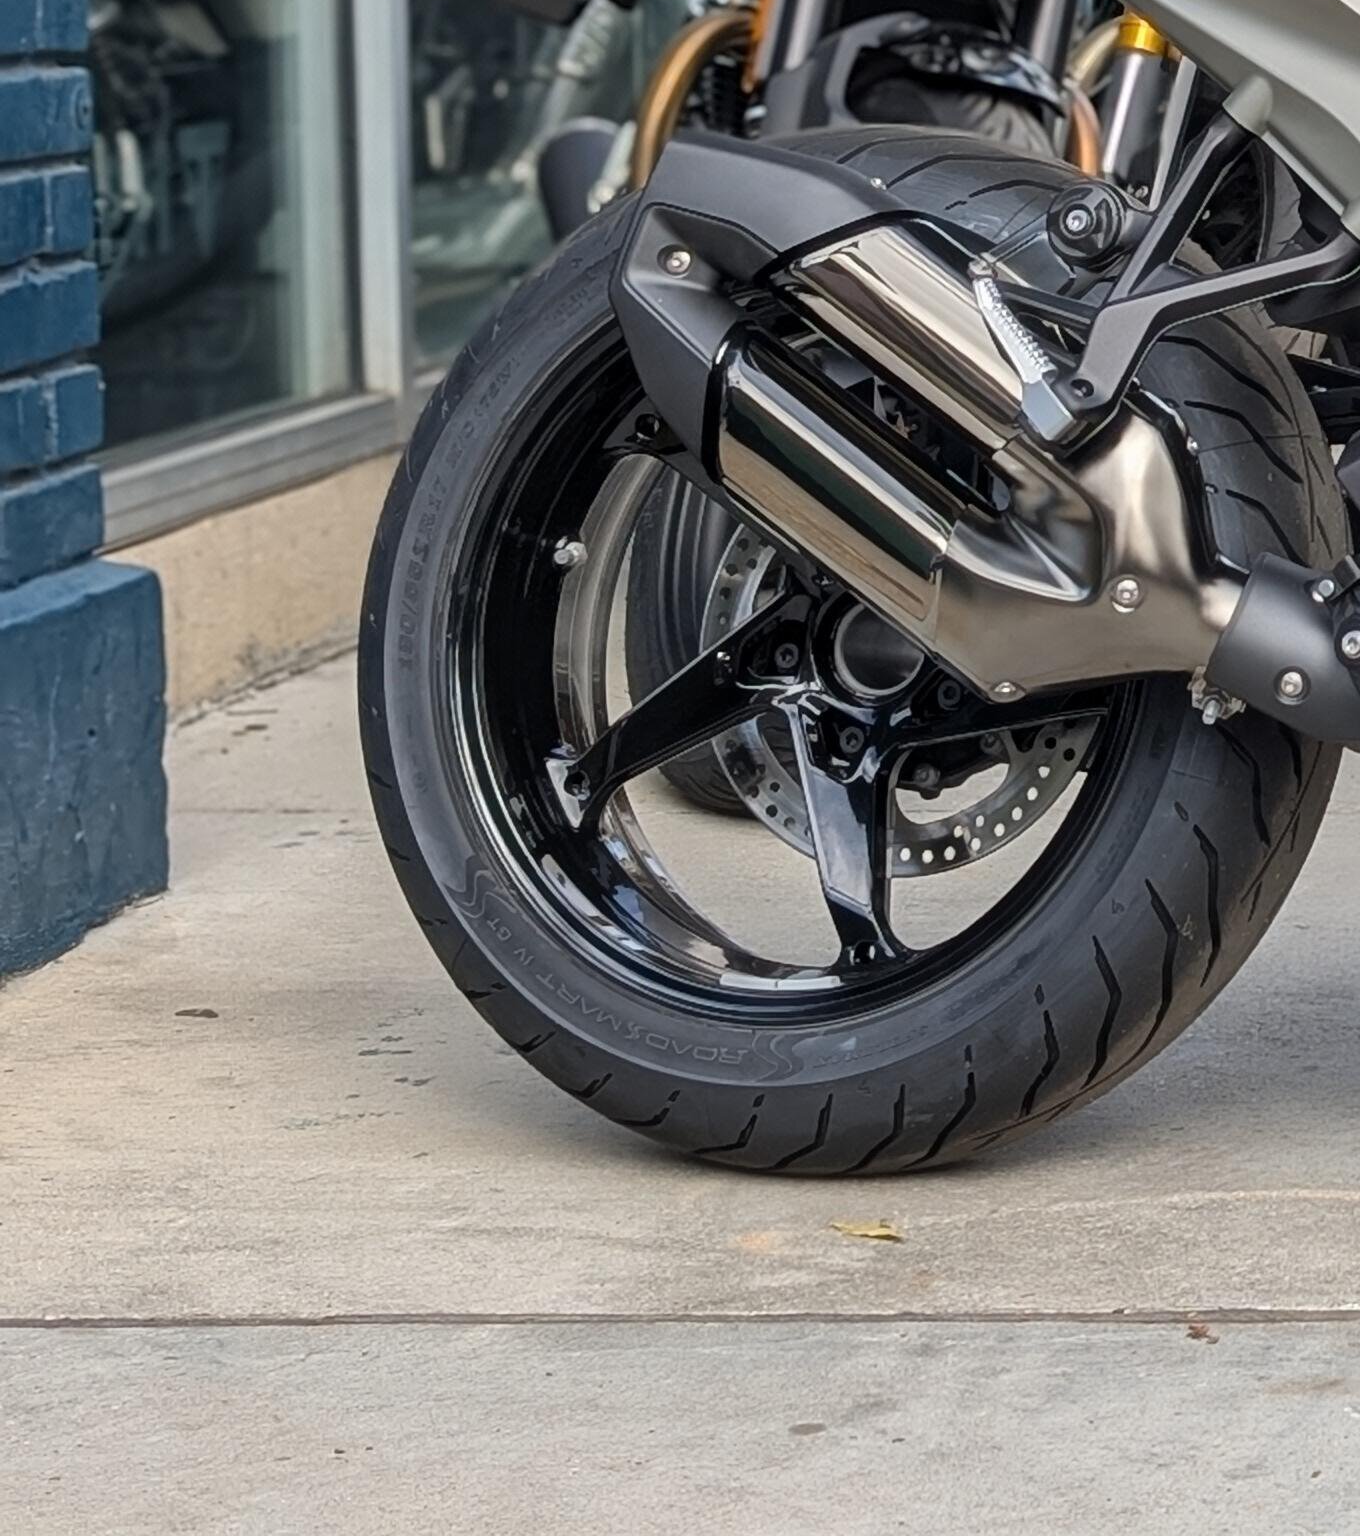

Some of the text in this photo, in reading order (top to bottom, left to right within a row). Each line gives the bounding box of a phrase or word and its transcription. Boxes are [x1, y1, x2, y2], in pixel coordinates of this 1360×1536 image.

[486, 917, 748, 1065] ROADSMART IV GT
